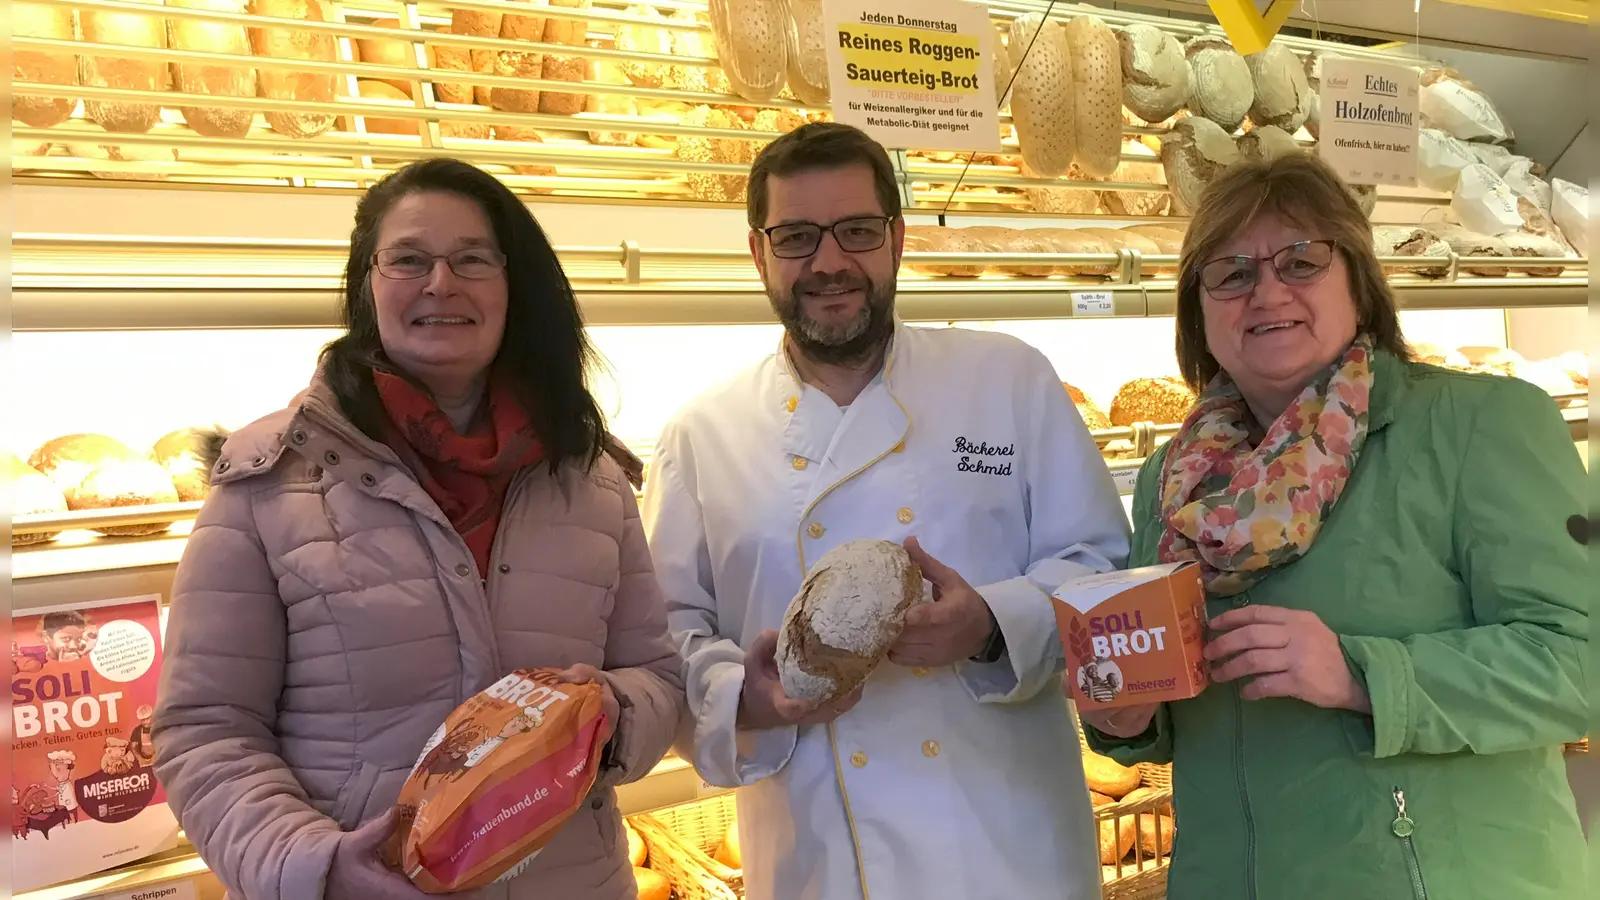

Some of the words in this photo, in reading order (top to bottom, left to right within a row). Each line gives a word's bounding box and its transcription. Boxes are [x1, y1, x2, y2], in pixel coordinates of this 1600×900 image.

[860, 11, 894, 25] Jeden
[897, 14, 957, 33] Donnerstag
[838, 31, 903, 53] Reines
[909, 37, 980, 62] Roggen-
[846, 63, 979, 91] Sauerteig-Brot
[1365, 74, 1398, 94] Echtes
[848, 101, 861, 111] für
[863, 102, 936, 117] Weizenallergiker
[938, 107, 954, 117] und
[956, 108, 968, 118] für
[970, 109, 983, 119] die
[1335, 100, 1413, 126] Holzofenbrot
[866, 117, 930, 130] Metabolic-Diät
[932, 121, 970, 133] geeignet
[1334, 138, 1372, 150] Ofenfrisch,
[1373, 141, 1385, 150] hier
[952, 436, 1015, 457] Bäckerei
[957, 456, 1013, 477] Schmid
[1089, 610, 1144, 637] SOLI
[1091, 626, 1167, 659] BROT
[12, 669, 92, 706] SOLI
[484, 673, 570, 713] BROT
[1127, 677, 1177, 692] misereor
[12, 691, 123, 739] BROT
[44, 734, 74, 746] Teilen.
[76, 730, 103, 743] Gutes
[104, 726, 123, 737] tun.
[83, 772, 151, 799] MISEREOR
[450, 787, 549, 862] www.frauenbund.de
[131, 887, 177, 900] Schrippen
